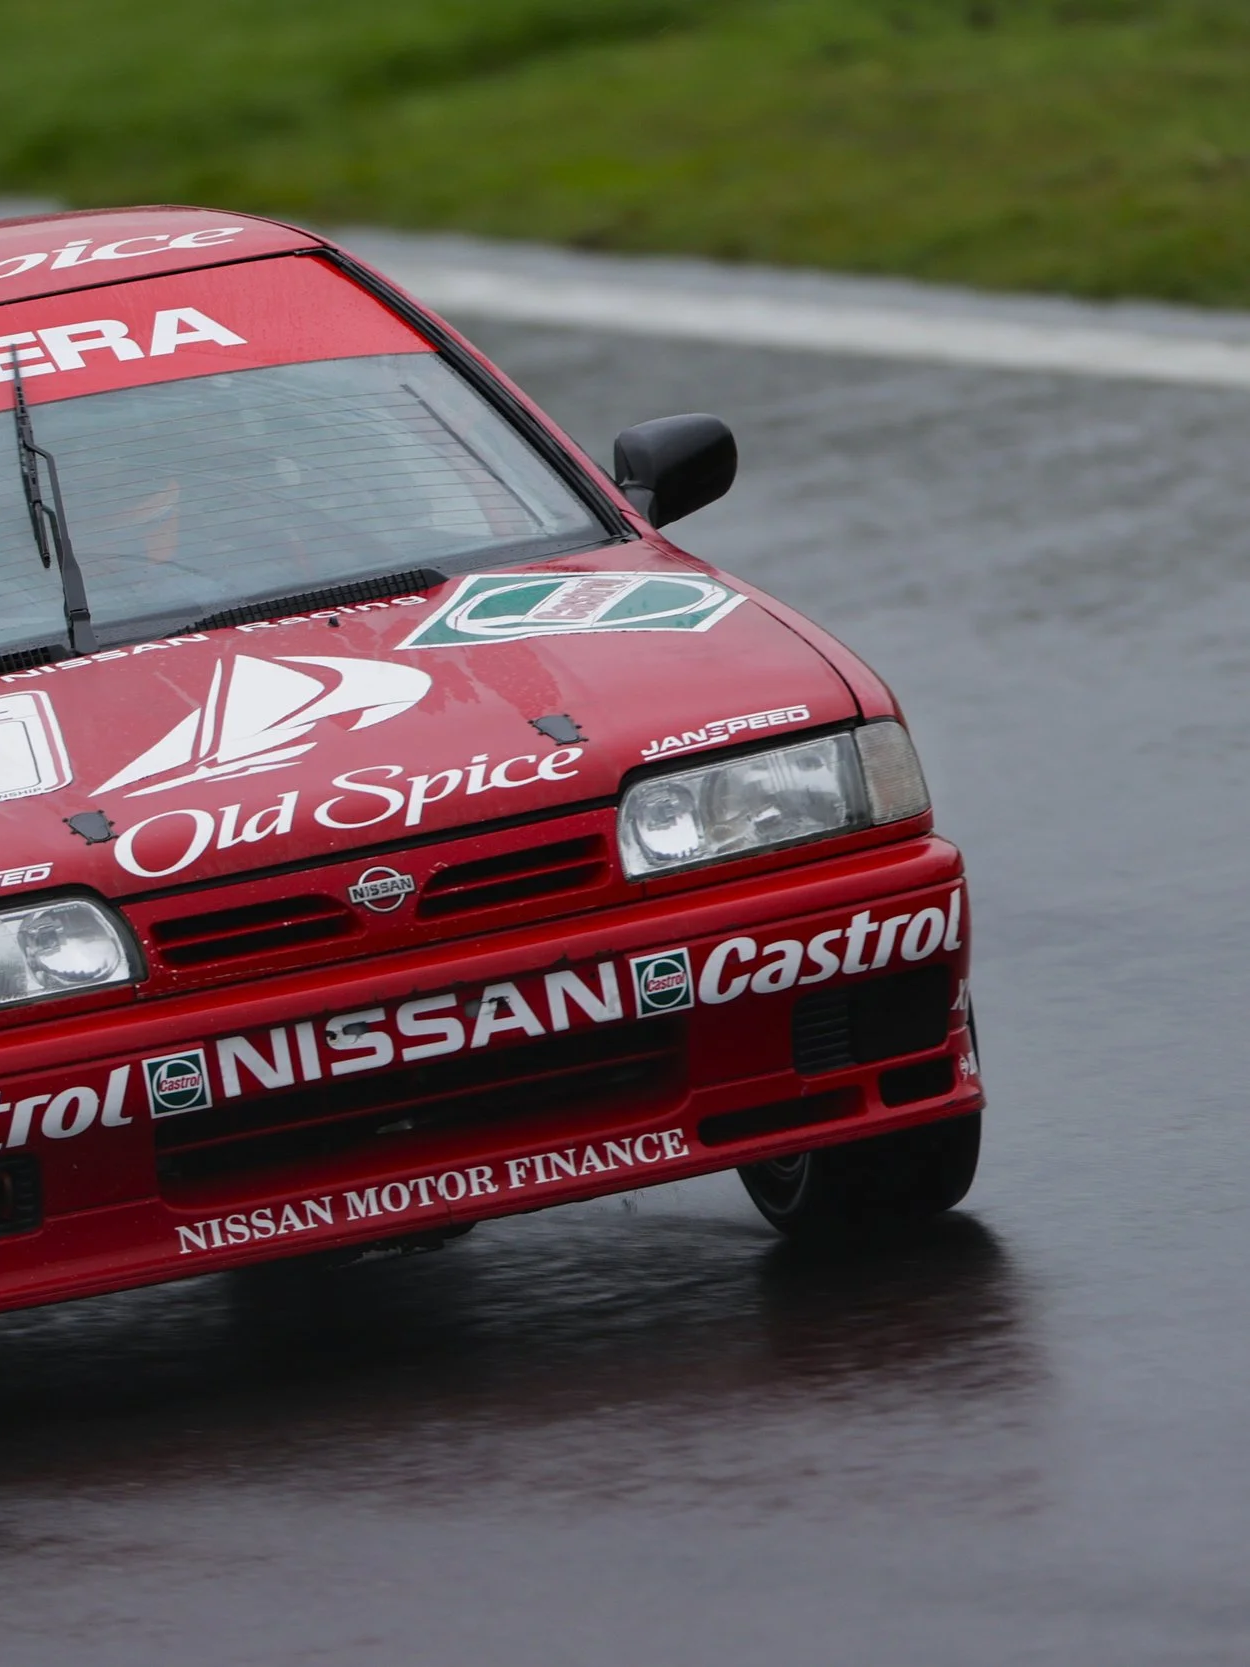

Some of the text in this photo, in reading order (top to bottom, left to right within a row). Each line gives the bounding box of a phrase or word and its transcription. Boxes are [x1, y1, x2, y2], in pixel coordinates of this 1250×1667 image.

[1, 594, 428, 683] NISSAN Racing
[642, 706, 811, 761] JANSPEED
[115, 746, 583, 876] Old Spice
[351, 875, 414, 903] NISSAN
[646, 970, 686, 995] Castrol
[699, 888, 962, 1006] Castrol
[216, 961, 622, 1097] NISSAN
[158, 1073, 202, 1095] Castrol
[175, 1126, 690, 1255] NISSAN MOTOR FINANCE
